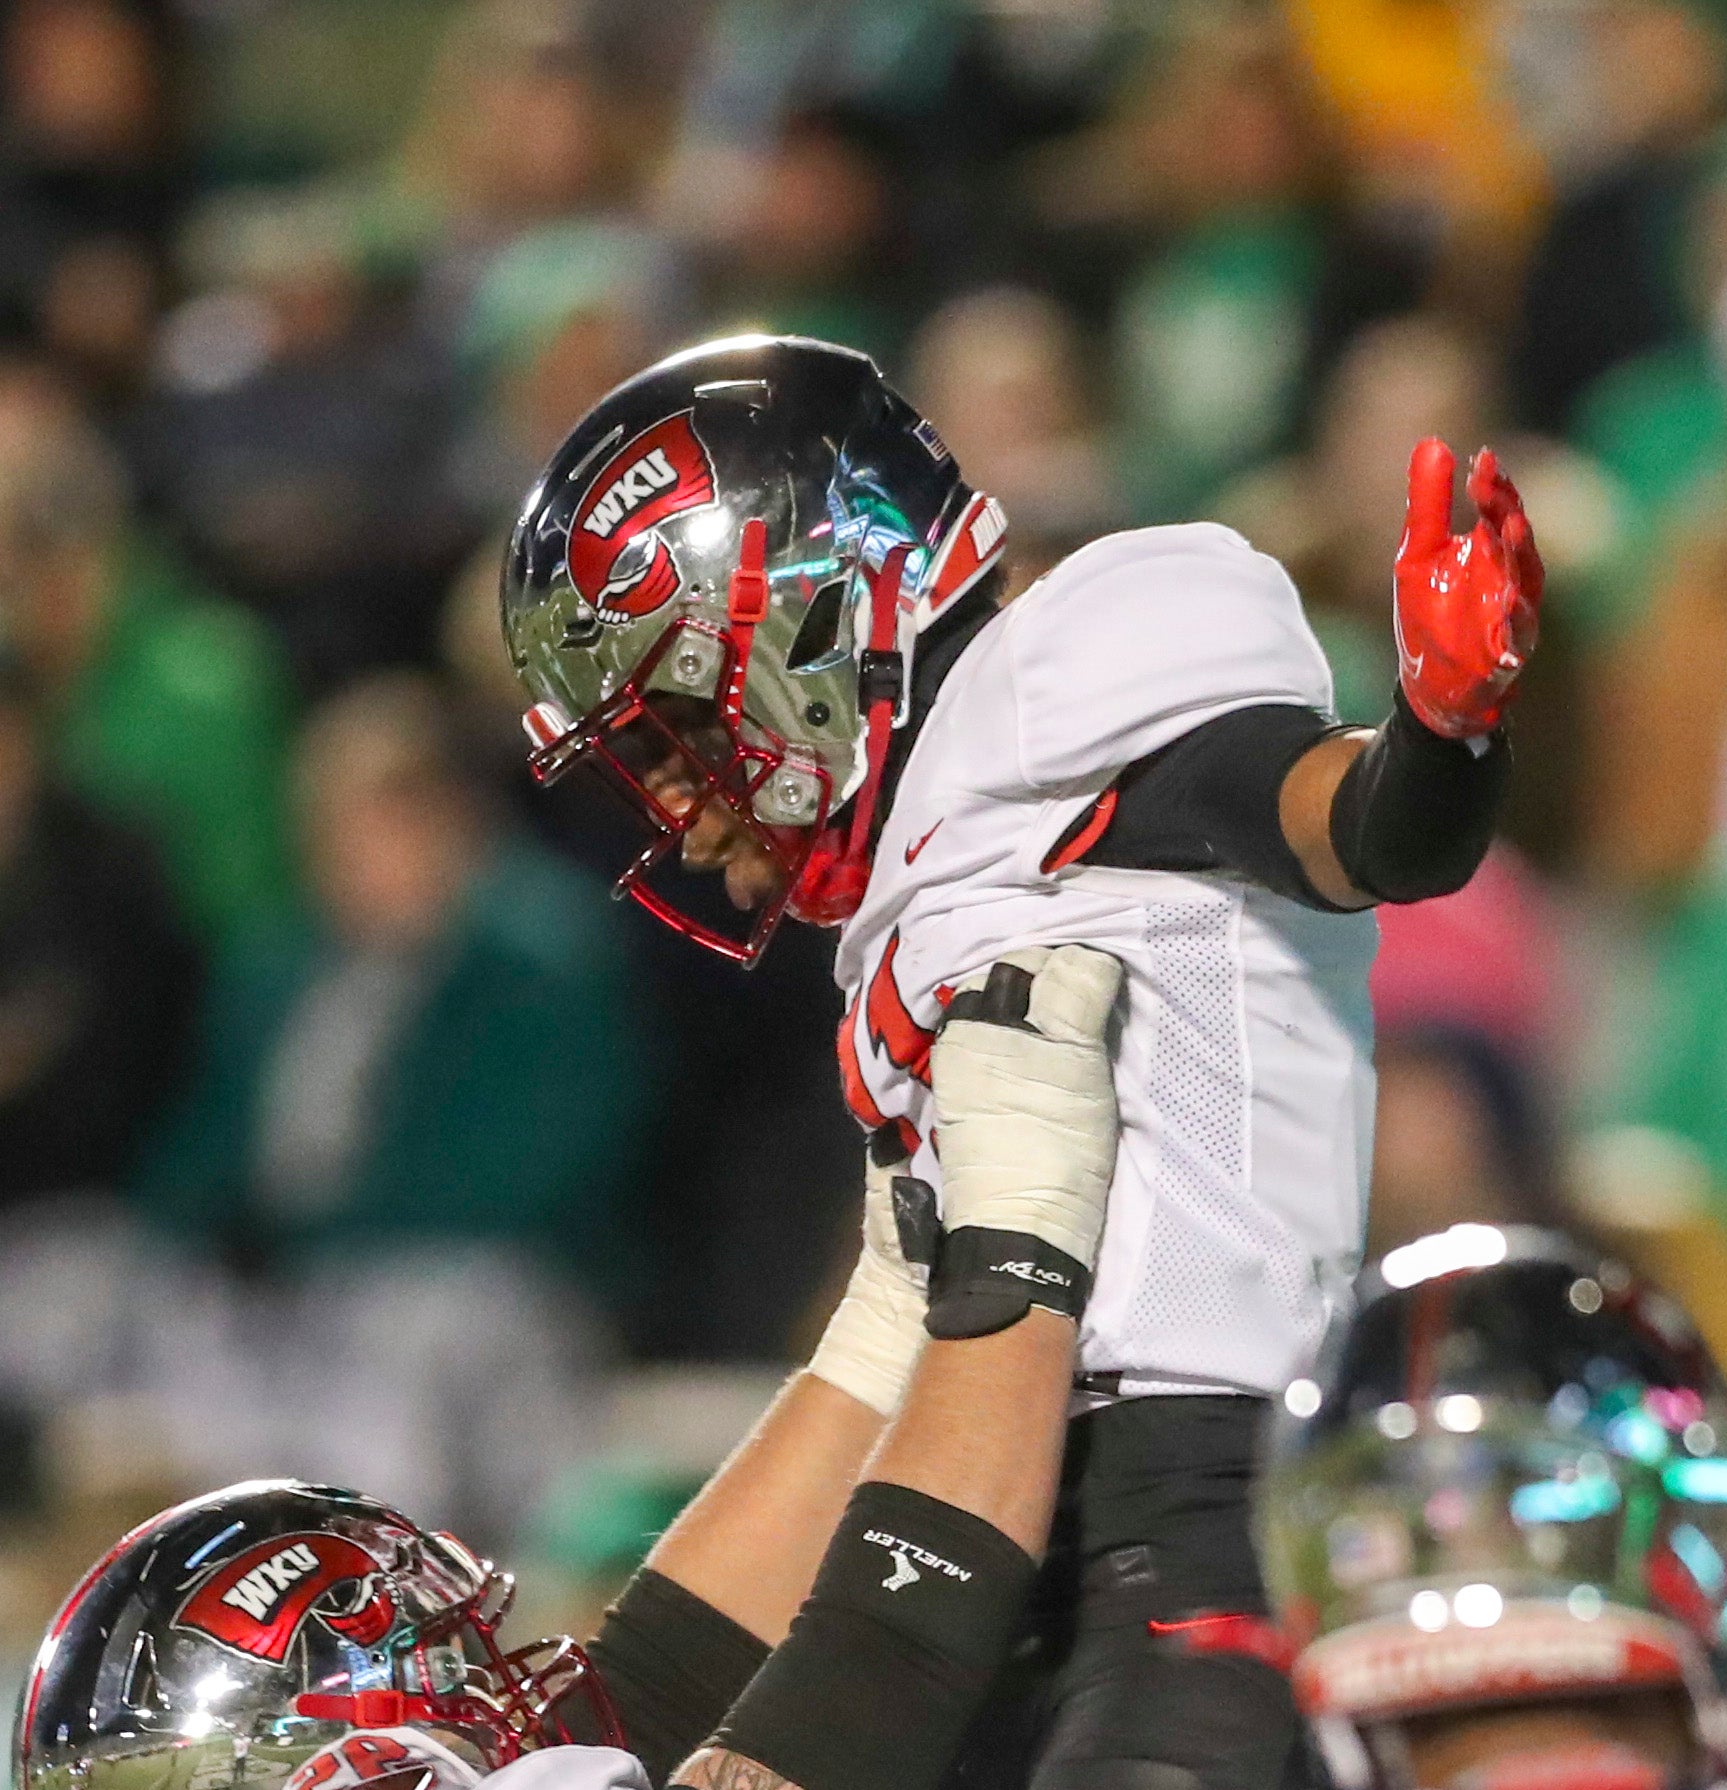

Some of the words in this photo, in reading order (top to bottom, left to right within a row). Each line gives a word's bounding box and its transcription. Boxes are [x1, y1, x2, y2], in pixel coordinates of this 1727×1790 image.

[582, 447, 678, 538] WKU
[221, 1542, 320, 1621] WKU
[862, 1529, 973, 1582] MUELLER
